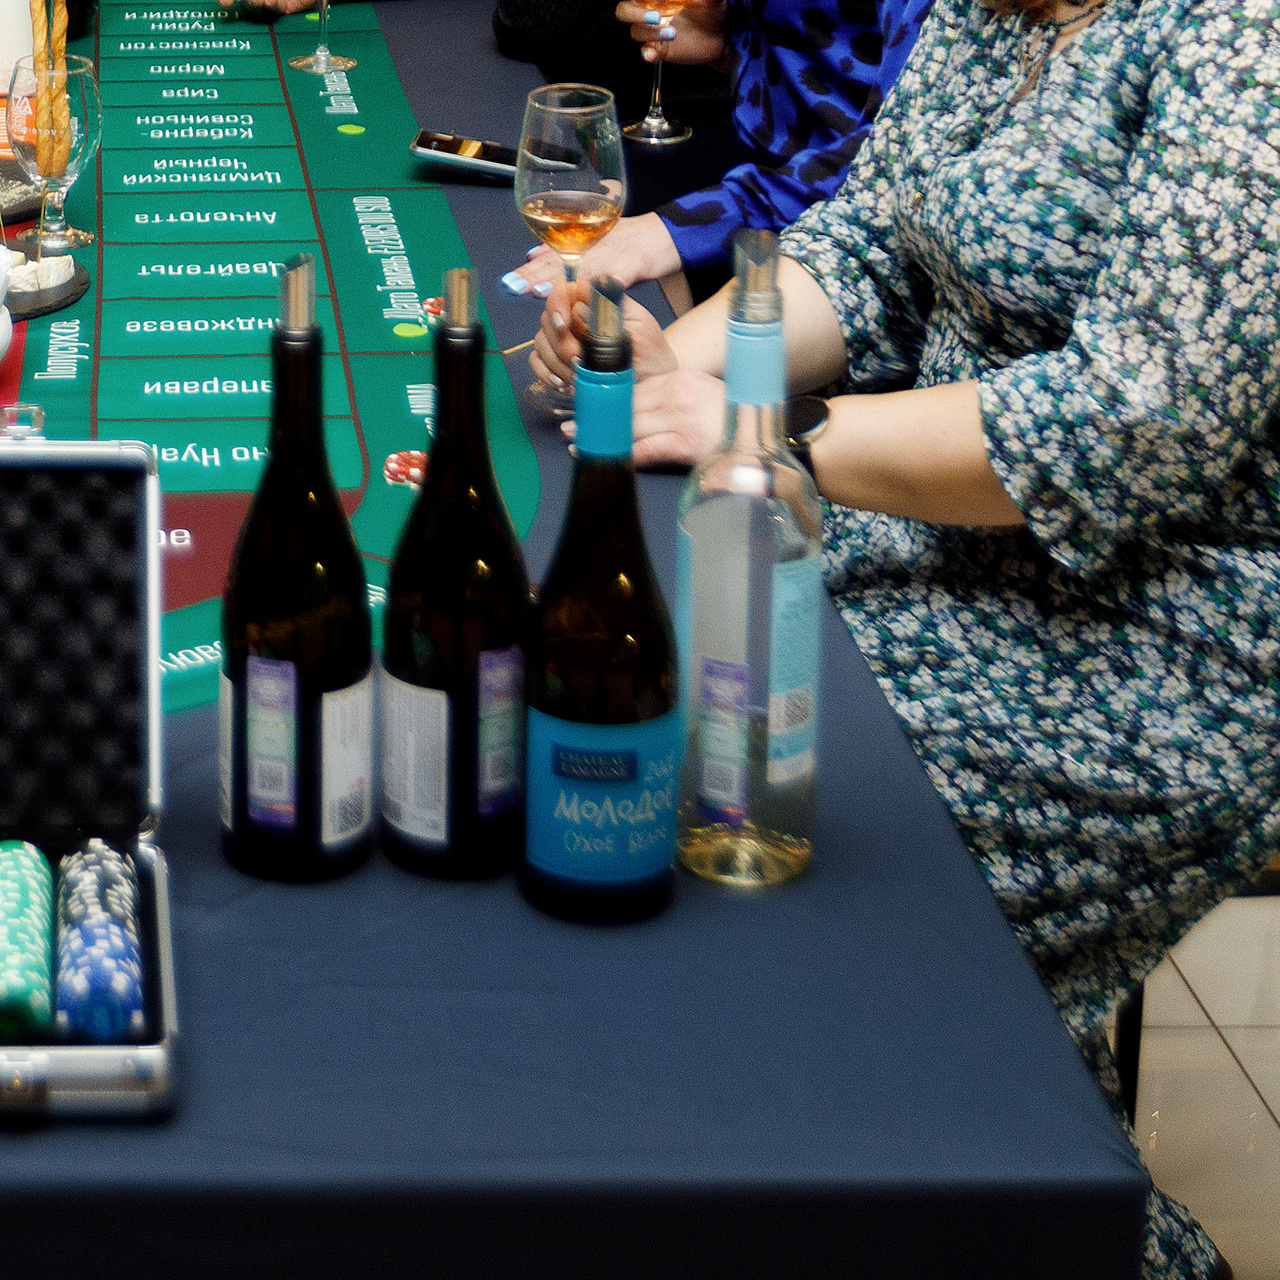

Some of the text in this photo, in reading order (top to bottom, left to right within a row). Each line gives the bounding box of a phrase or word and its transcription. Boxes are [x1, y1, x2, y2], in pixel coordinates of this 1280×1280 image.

[125, 9, 239, 21] Голодриги
[151, 20, 215, 31] Рубин
[120, 39, 250, 50] Красностоп
[150, 64, 224, 75] Мерло
[162, 87, 218, 99] Сира
[137, 114, 254, 126] Совиньон
[154, 157, 248, 172] Черный
[122, 169, 282, 187] Цимлянский
[135, 212, 276, 224] Анчелотта
[126, 319, 279, 335] нджовезе
[33, 319, 90, 380] Полусухое
[144, 378, 273, 397] аперави
